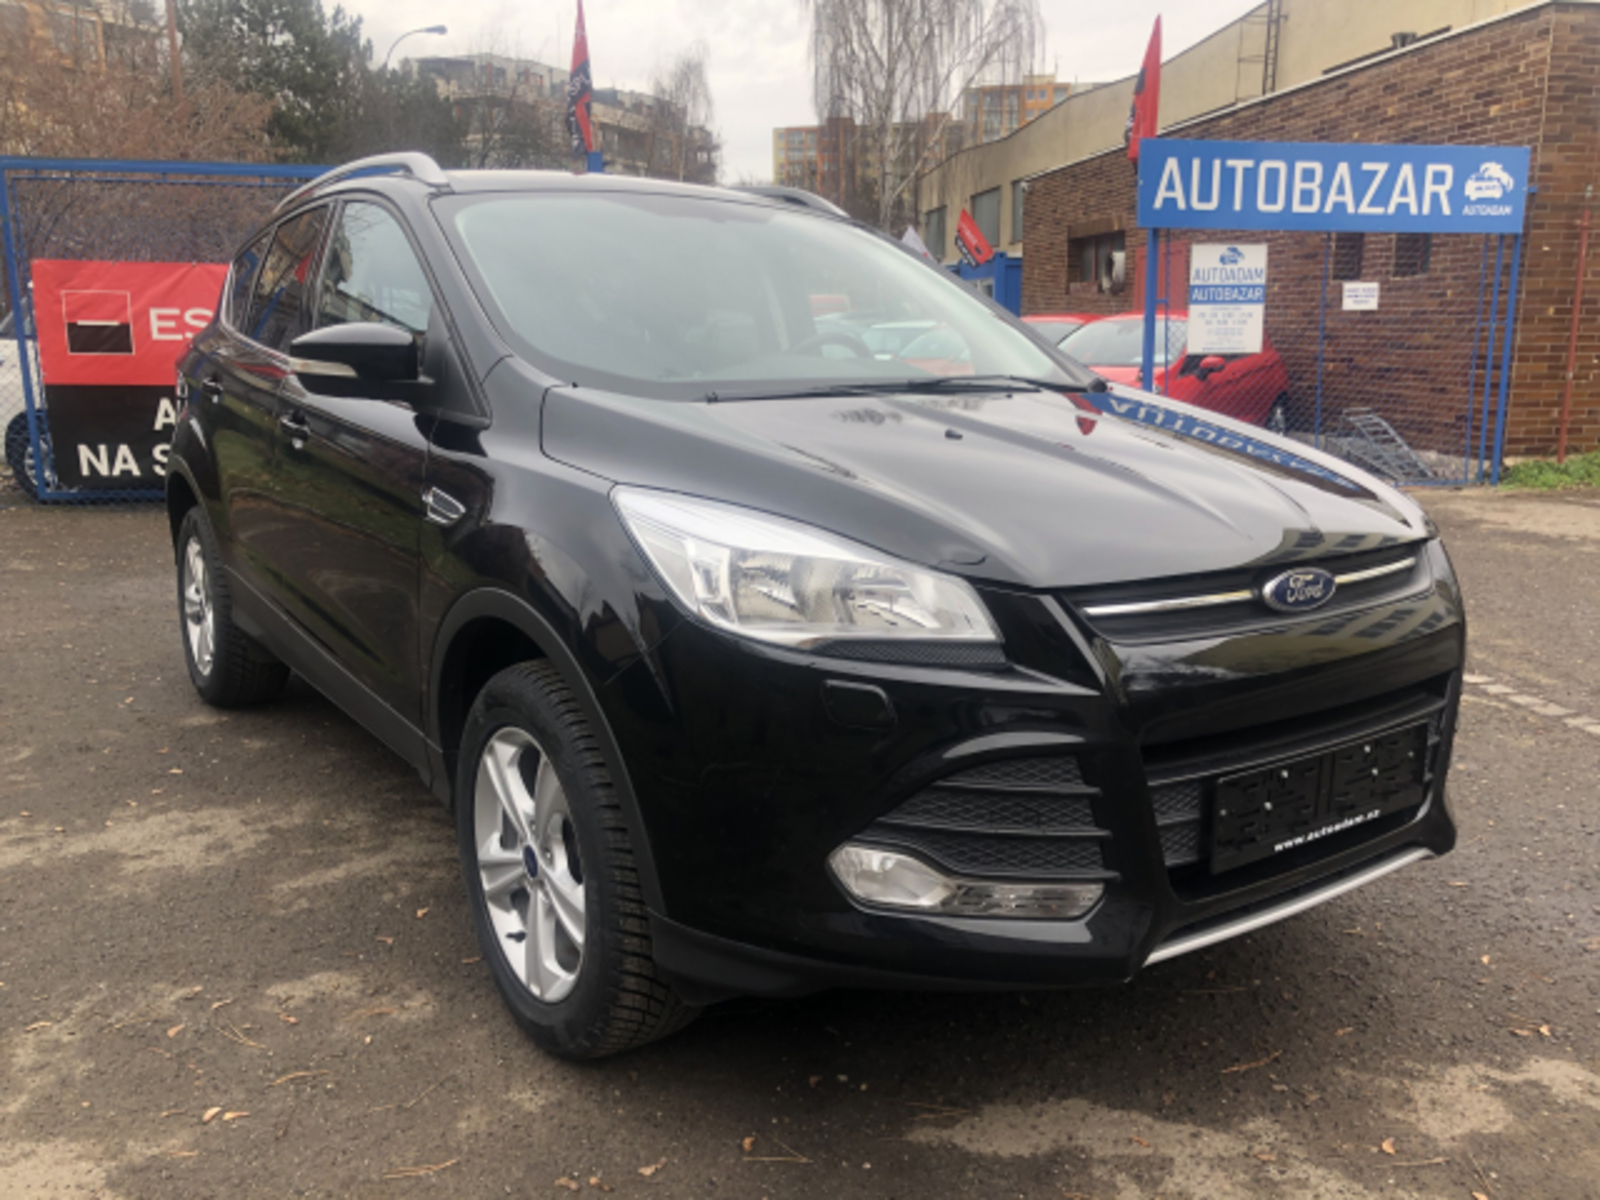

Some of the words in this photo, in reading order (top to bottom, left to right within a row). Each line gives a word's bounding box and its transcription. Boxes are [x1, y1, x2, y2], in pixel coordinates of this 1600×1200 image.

[1153, 156, 1454, 216] AUTOBAZAR
[1192, 266, 1264, 283] AUTOADAM
[1191, 286, 1264, 302] AUTOBAZAR
[77, 444, 141, 477] NA
[1286, 574, 1324, 604] Ford
